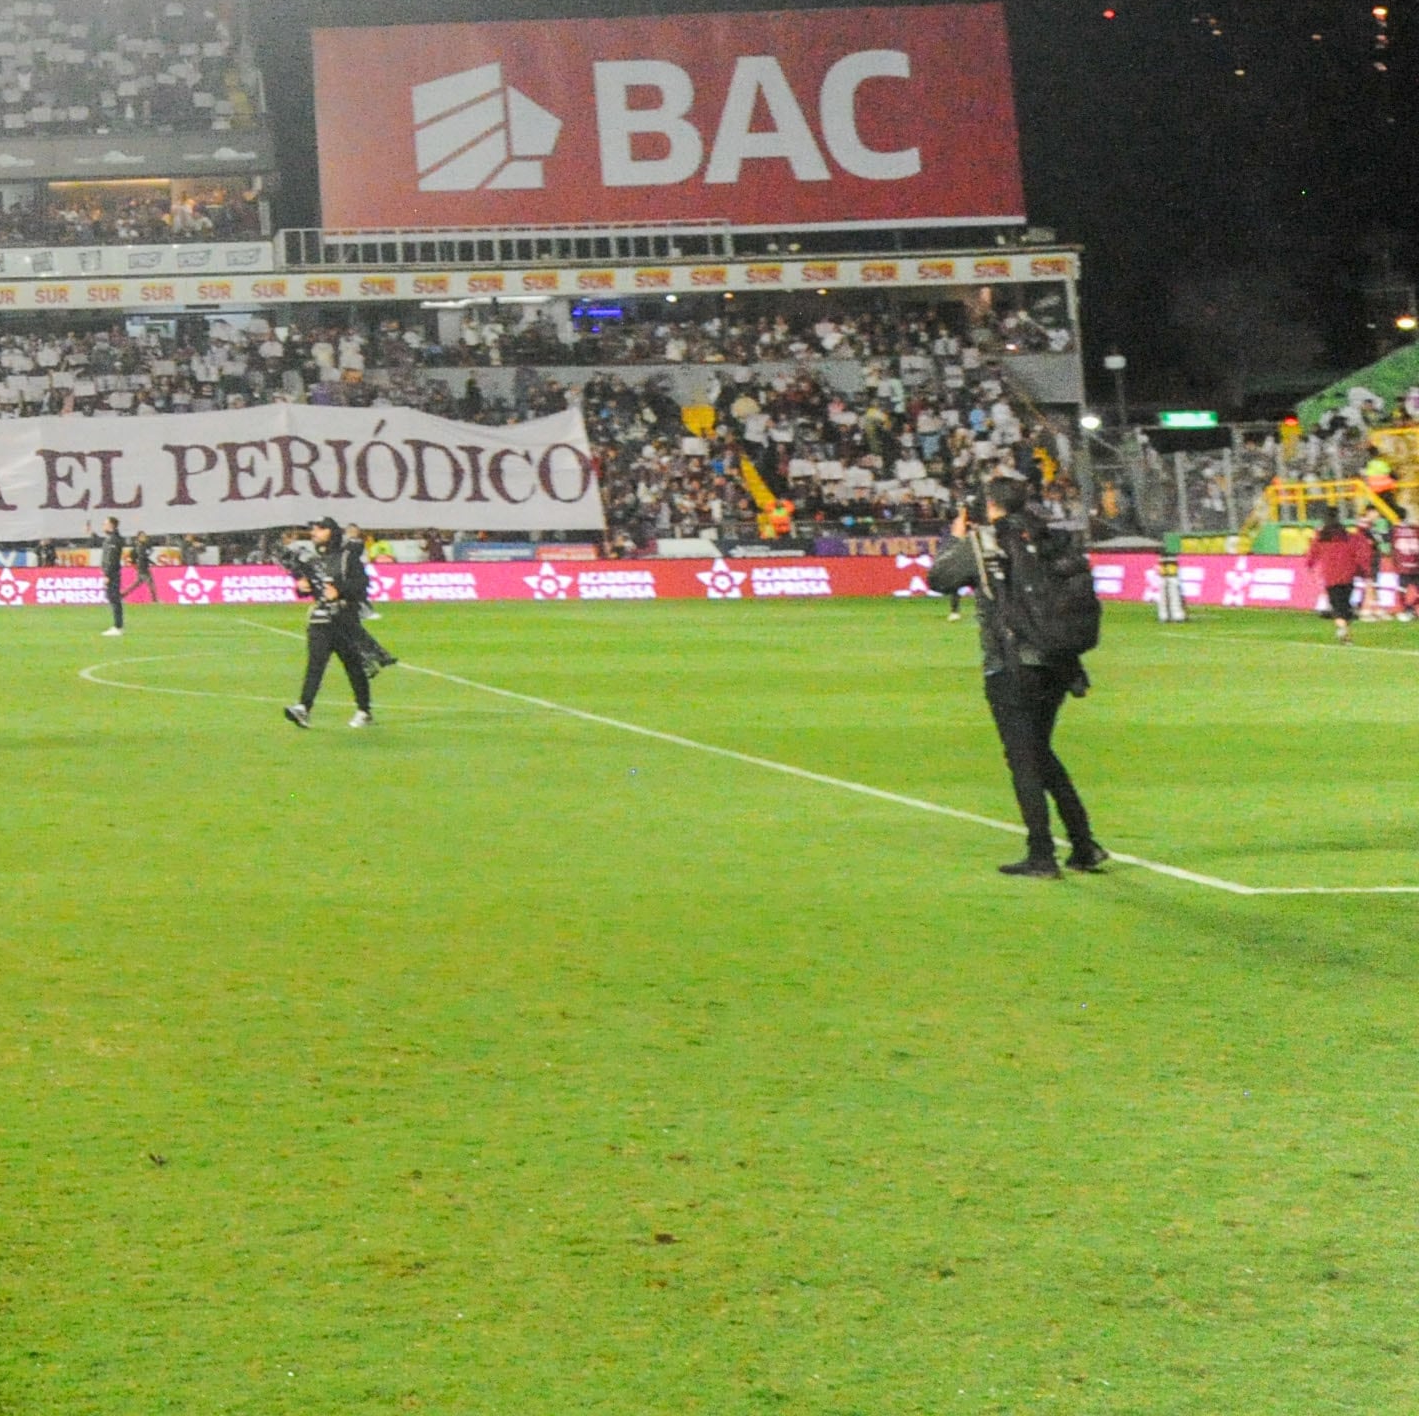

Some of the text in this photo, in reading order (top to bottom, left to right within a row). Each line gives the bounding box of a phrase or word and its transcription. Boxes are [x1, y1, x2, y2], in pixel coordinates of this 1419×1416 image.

[592, 49, 923, 187] BAC
[35, 288, 69, 304] SUR
[87, 287, 121, 303] SUR
[140, 285, 175, 302] SUR
[198, 284, 233, 300] SUR
[35, 448, 144, 511] EL
[161, 418, 595, 508] PERIÓDICO
[578, 571, 655, 585] ACADEMIA
[751, 566, 830, 582] ACADEMIA
[35, 577, 108, 590] ACADEMIA
[222, 575, 295, 589] ACADEMIA
[753, 581, 832, 597] SAPRISSA
[36, 590, 109, 604] SAPRISSA
[222, 588, 296, 602] SAPRISSA
[579, 584, 657, 599] SAPRISSA
